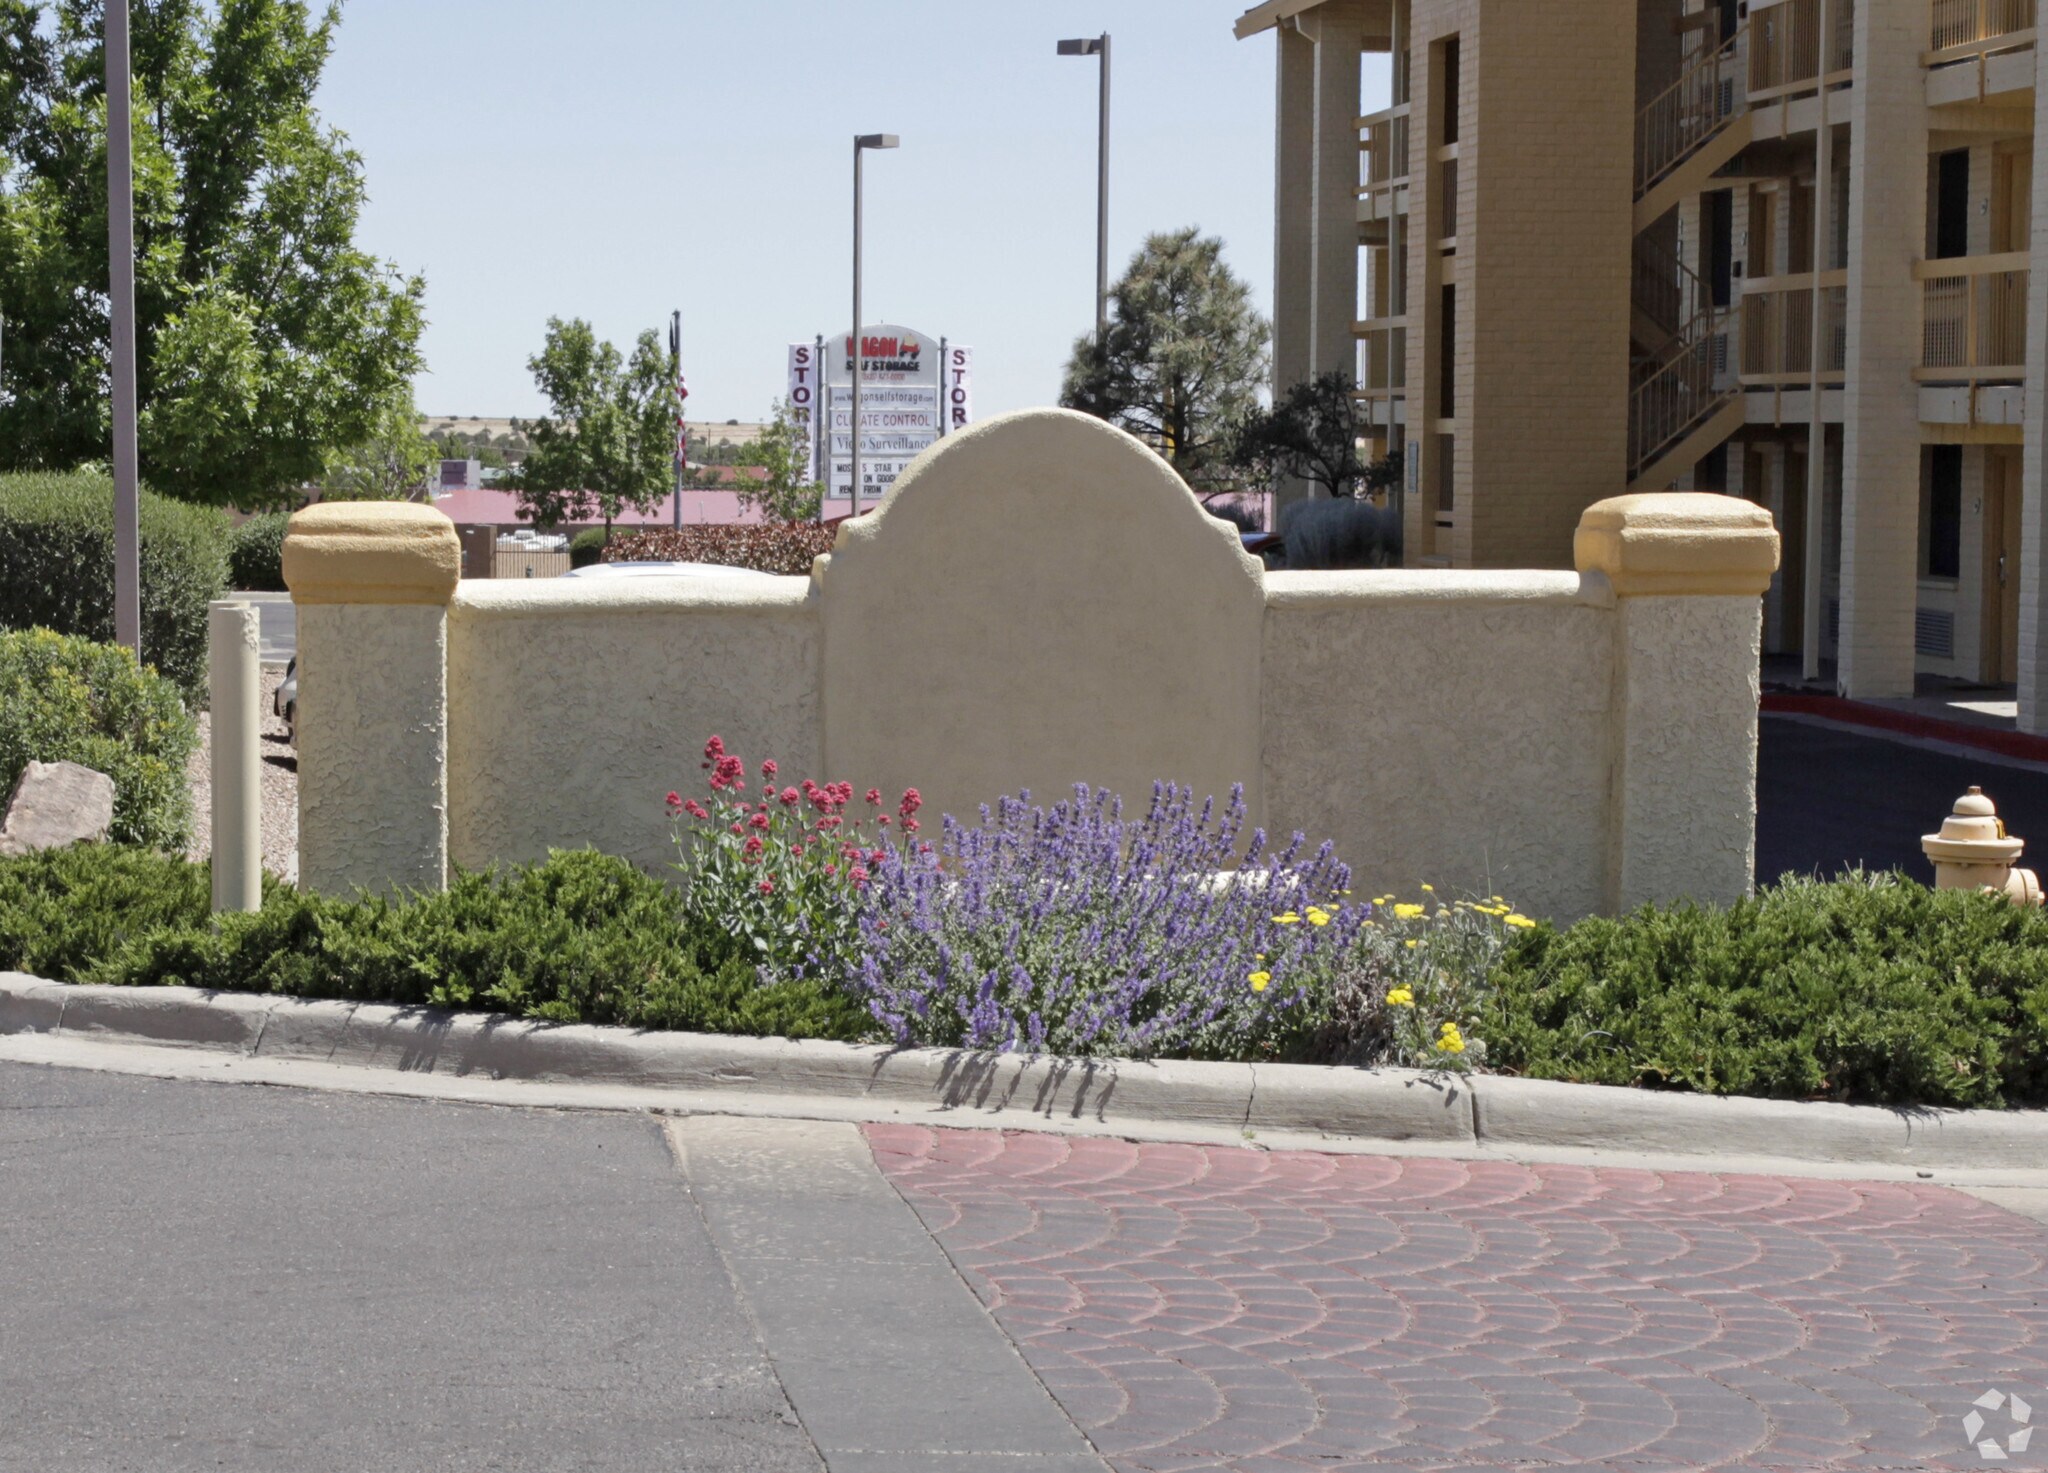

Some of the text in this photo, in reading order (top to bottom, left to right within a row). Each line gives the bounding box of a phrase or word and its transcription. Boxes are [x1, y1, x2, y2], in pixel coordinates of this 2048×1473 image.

[846, 361, 920, 372] SLF STORAGE
[835, 391, 933, 405] www.wgonselfstorage.com
[836, 414, 930, 426] CLIATE CONTROL
[869, 437, 931, 449] Surveillance
[874, 464, 892, 473] STAR
[863, 474, 873, 483] ON
[863, 485, 882, 494] FROM
